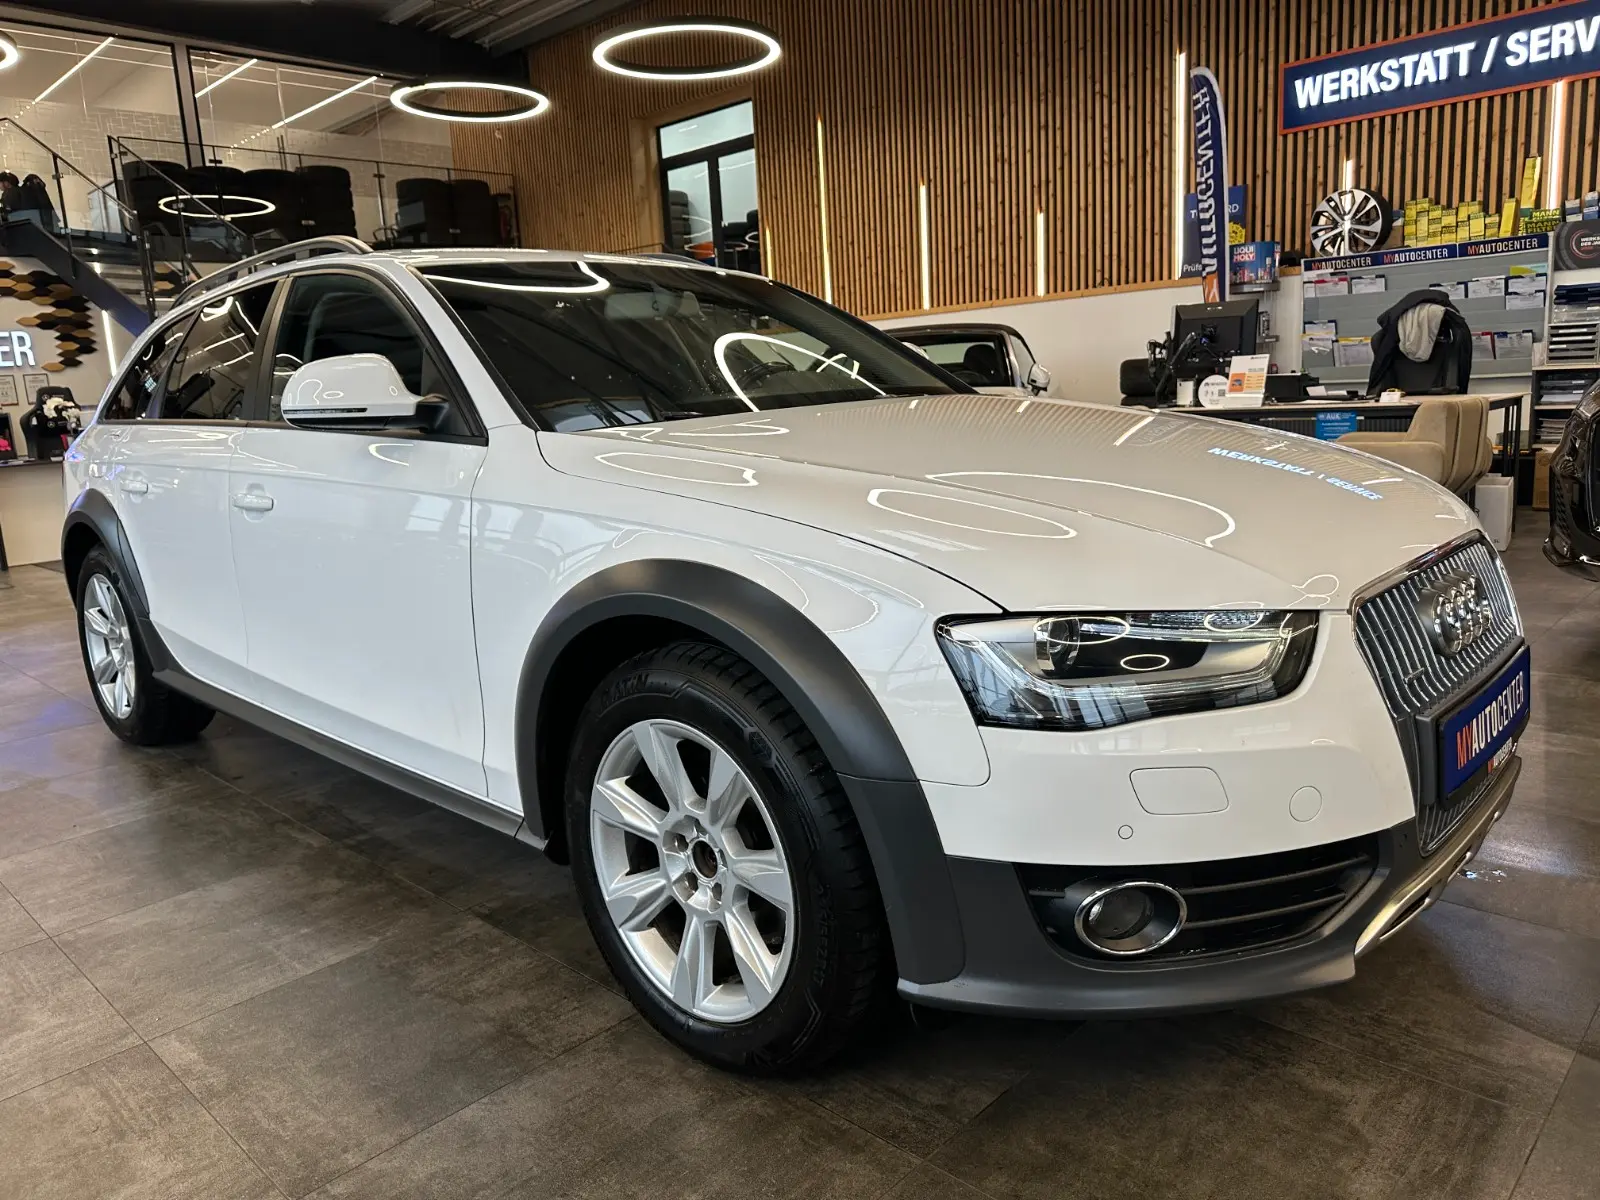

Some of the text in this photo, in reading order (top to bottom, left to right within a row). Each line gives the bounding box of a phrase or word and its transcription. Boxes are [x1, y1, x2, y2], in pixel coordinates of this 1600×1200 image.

[1294, 41, 1477, 109] WERKSTATT
[1505, 16, 1600, 67] SERV
[1234, 245, 1255, 254] LIQUI
[1467, 238, 1538, 255] MYAUTOCENTER
[1233, 253, 1256, 262] MOLY
[1383, 248, 1448, 263] MYAUTOCENTER
[1312, 257, 1372, 270] MYAUTOCENTER
[1456, 671, 1524, 770] MYAUTOCENTER
